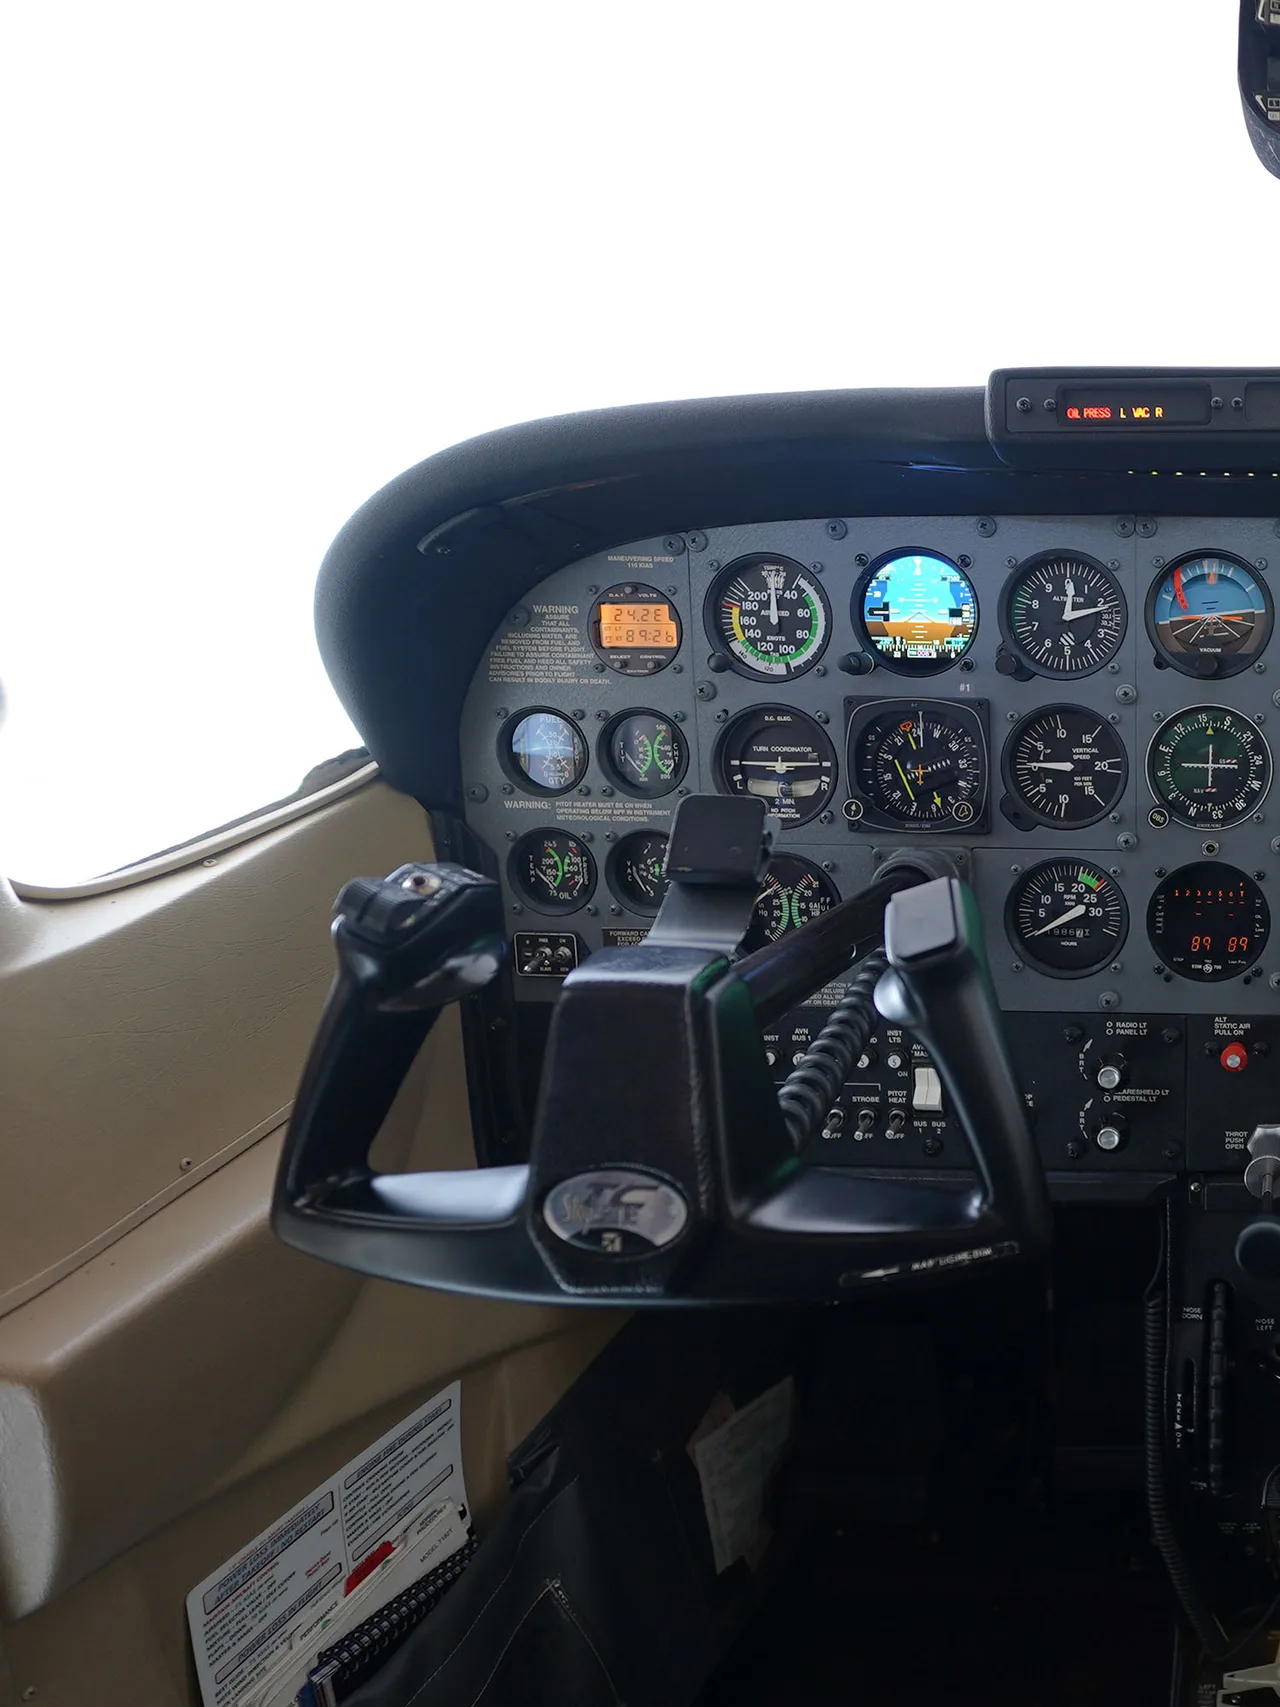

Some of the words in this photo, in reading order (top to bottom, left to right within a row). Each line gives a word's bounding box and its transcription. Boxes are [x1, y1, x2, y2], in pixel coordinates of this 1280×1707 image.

[1067, 408, 1081, 419] OIL
[1084, 408, 1112, 419] PRESS
[1120, 408, 1126, 418] L
[1132, 408, 1150, 418] VAC
[1156, 408, 1163, 418] R
[1046, 584, 1053, 593] 9
[748, 592, 768, 601] 200
[784, 590, 798, 599] 40
[742, 602, 759, 610] 180
[1032, 600, 1039, 609] 8
[533, 605, 579, 614] WARNING
[797, 609, 810, 618] 60
[741, 617, 756, 625] 160
[1032, 622, 1039, 631] 7
[745, 629, 761, 638] 140
[796, 630, 809, 639] 80
[1098, 629, 1105, 638] 3
[758, 642, 773, 651] 120
[779, 645, 795, 654] 100
[1045, 639, 1052, 648] 6
[1084, 640, 1091, 648] 4
[1064, 647, 1071, 655] 5
[960, 684, 970, 692] #1
[1198, 714, 1207, 722] 15
[1174, 723, 1185, 734] 12
[1057, 729, 1067, 738] 10
[1243, 731, 1254, 742] 21
[894, 736, 904, 746] 21
[1083, 735, 1092, 743] 15
[948, 741, 959, 751] 30
[1254, 754, 1263, 765] 24
[1095, 762, 1108, 771] 20
[549, 777, 565, 785] QTY
[821, 783, 828, 791] R
[1085, 787, 1094, 795] 15
[1059, 795, 1069, 803] 10
[504, 801, 552, 810] WARNING:
[1055, 883, 1064, 892] 15
[1072, 884, 1085, 893] 20
[1041, 895, 1051, 904] 10
[1083, 894, 1097, 903] 25
[1089, 908, 1103, 917] 30
[218, 1562, 247, 1592] POWER
[250, 1545, 268, 1566] LOSS
[270, 1503, 320, 1549] IMMEDIATELY
[215, 1579, 240, 1605] AFTER
[241, 1550, 275, 1582] TAKEOFF
[280, 1534, 294, 1550] NO
[295, 1508, 325, 1538] RESTART
[300, 1600, 338, 1642] PERFORMANCE
